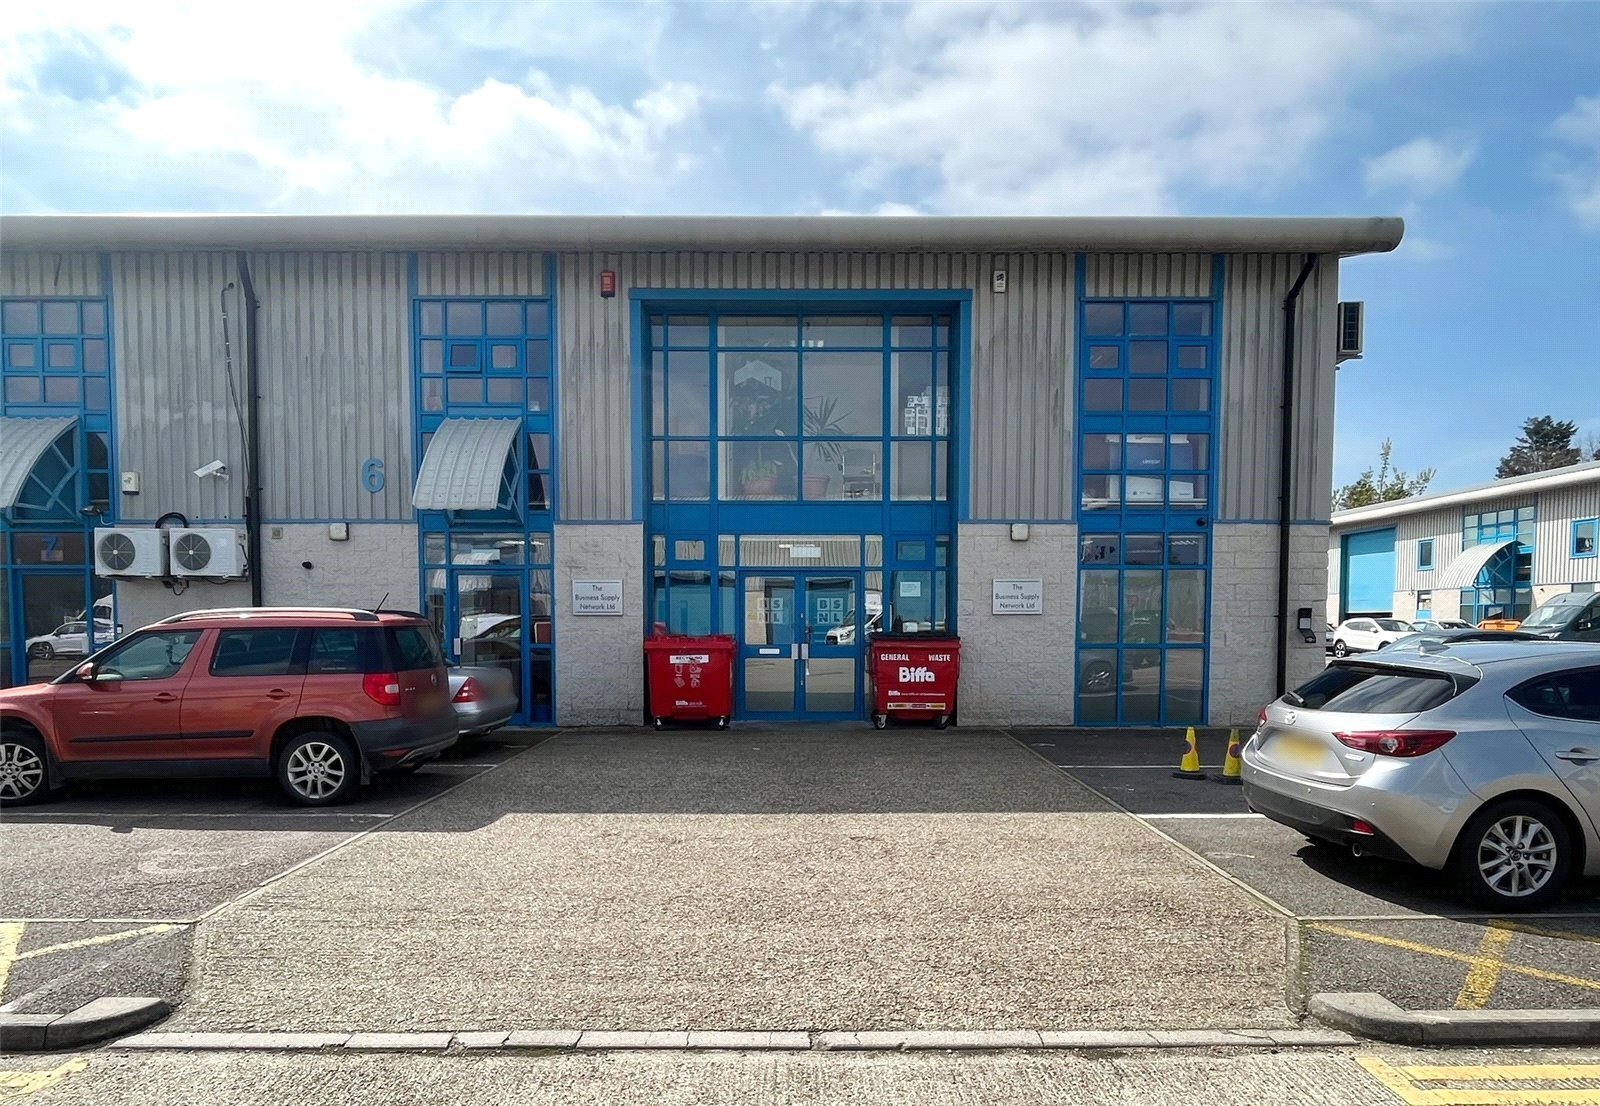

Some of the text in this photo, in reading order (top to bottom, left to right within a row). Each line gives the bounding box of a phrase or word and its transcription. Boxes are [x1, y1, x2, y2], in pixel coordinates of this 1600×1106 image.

[361, 458, 385, 494] 6
[41, 535, 58, 560] 7
[600, 593, 620, 602] Supply
[1020, 592, 1040, 600] Supply
[880, 653, 951, 662] GENERAL WASTE
[898, 666, 936, 683] Biffa
